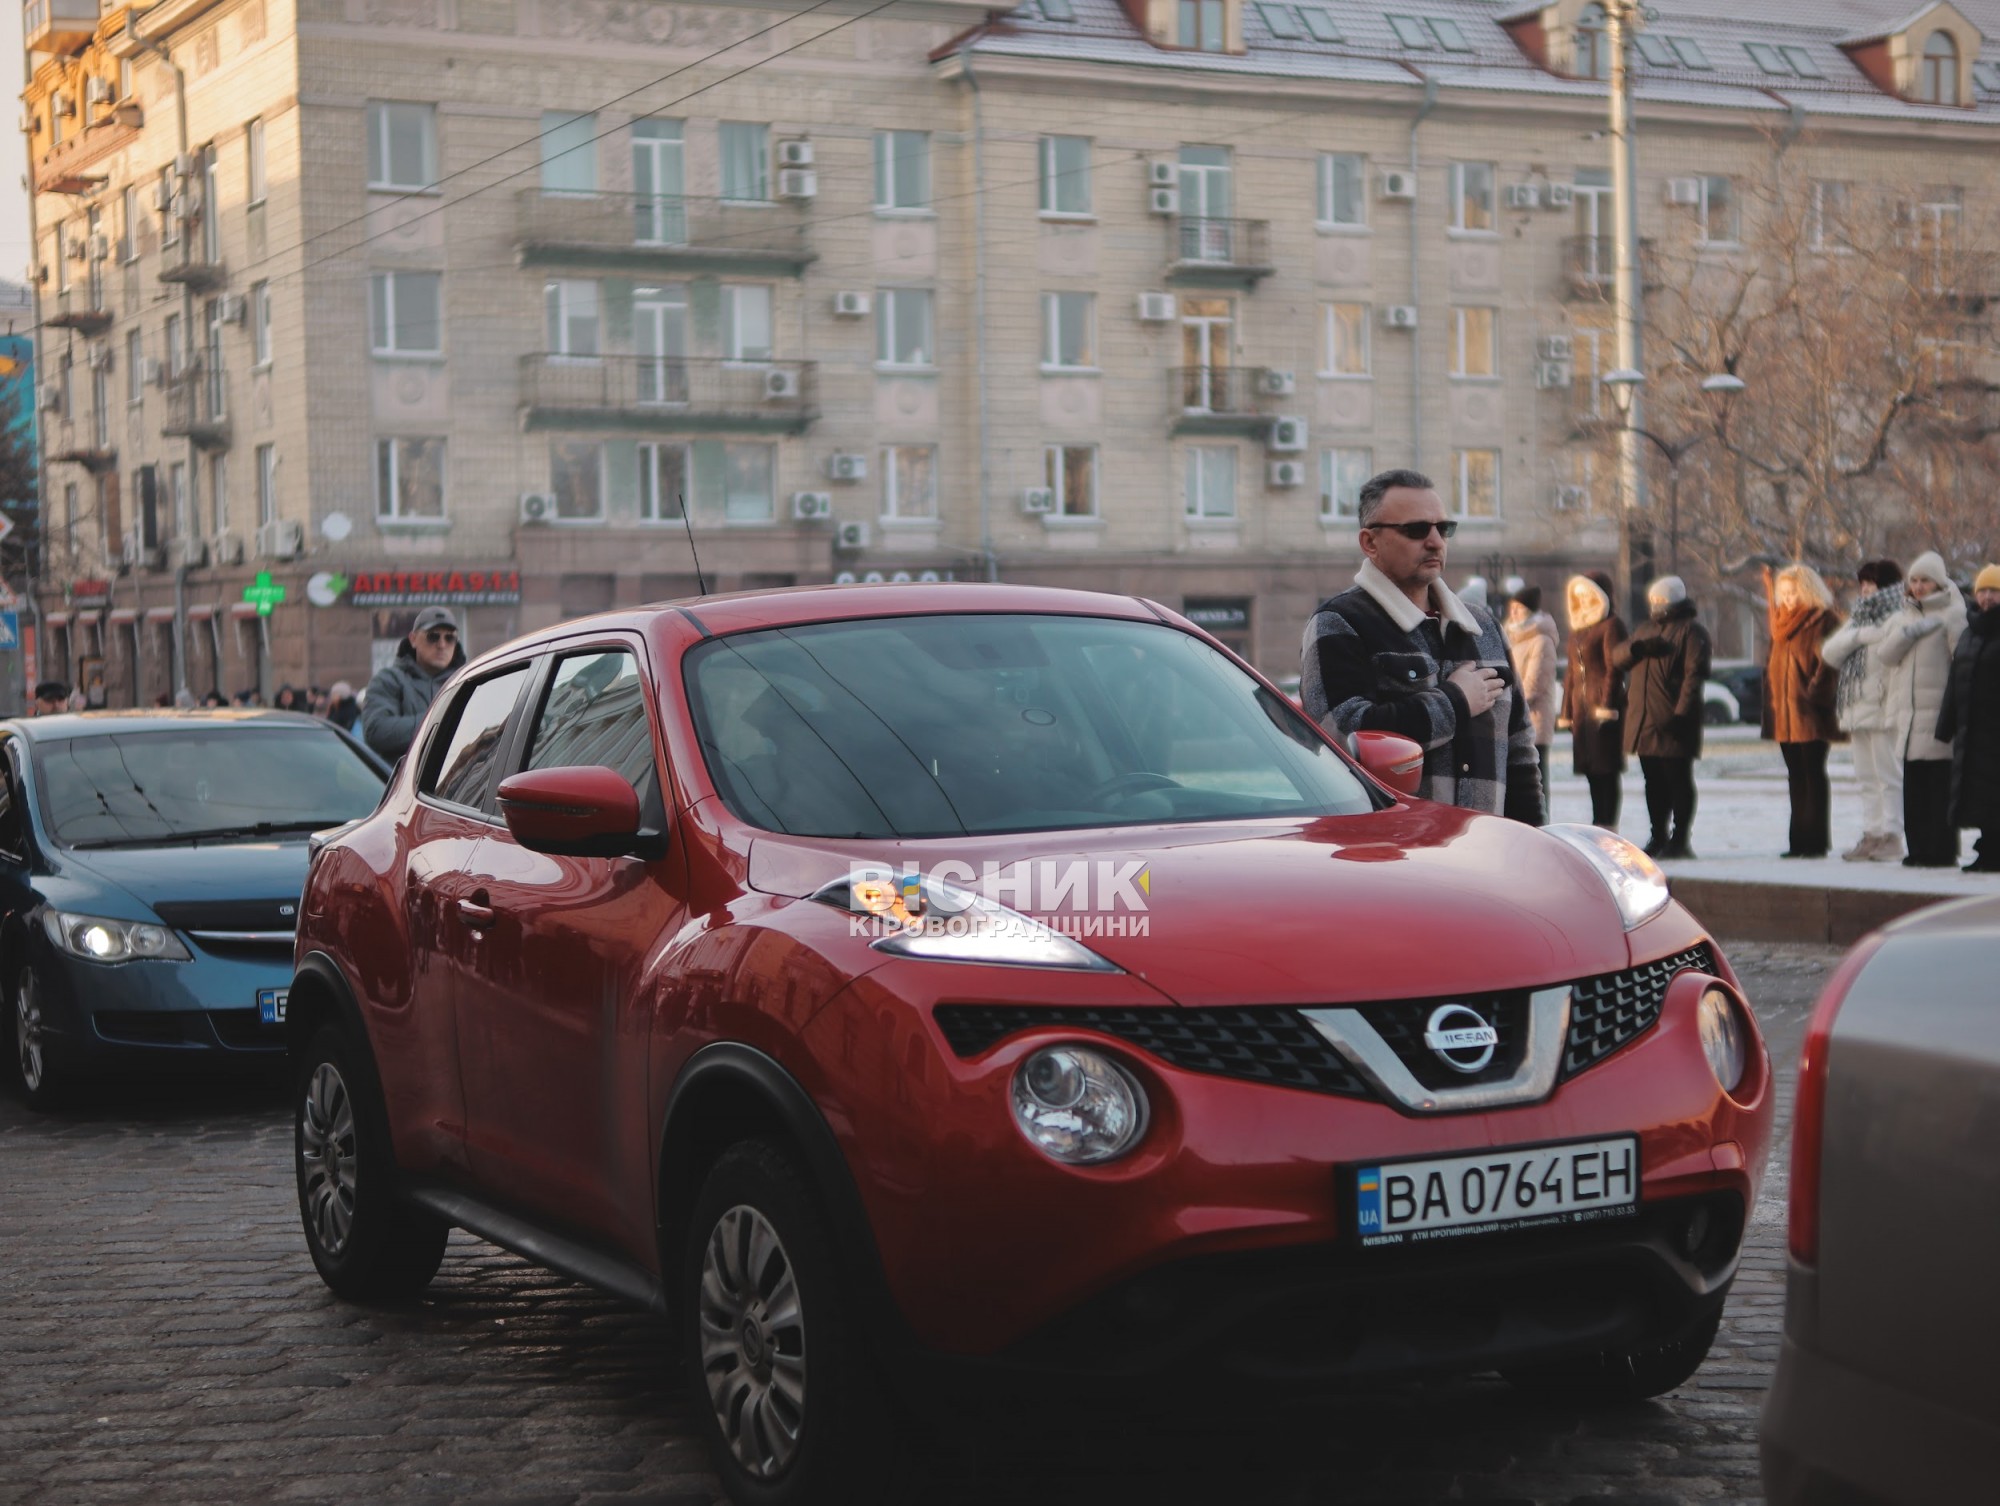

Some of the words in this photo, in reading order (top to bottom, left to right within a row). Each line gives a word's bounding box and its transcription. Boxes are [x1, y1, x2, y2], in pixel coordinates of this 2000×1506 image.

[354, 571, 464, 592] АПТЕКА
[406, 593, 448, 603] АПТЕКА
[264, 1011, 274, 1020] UA
[1385, 1172, 1451, 1224] BA
[1461, 1157, 1563, 1215] 0764
[1571, 1148, 1632, 1202] EH
[1359, 1210, 1379, 1226] UA
[1362, 1233, 1403, 1247] NISSAN
[1430, 1222, 1500, 1239] КРОПИВНИЦЬКИЙ
